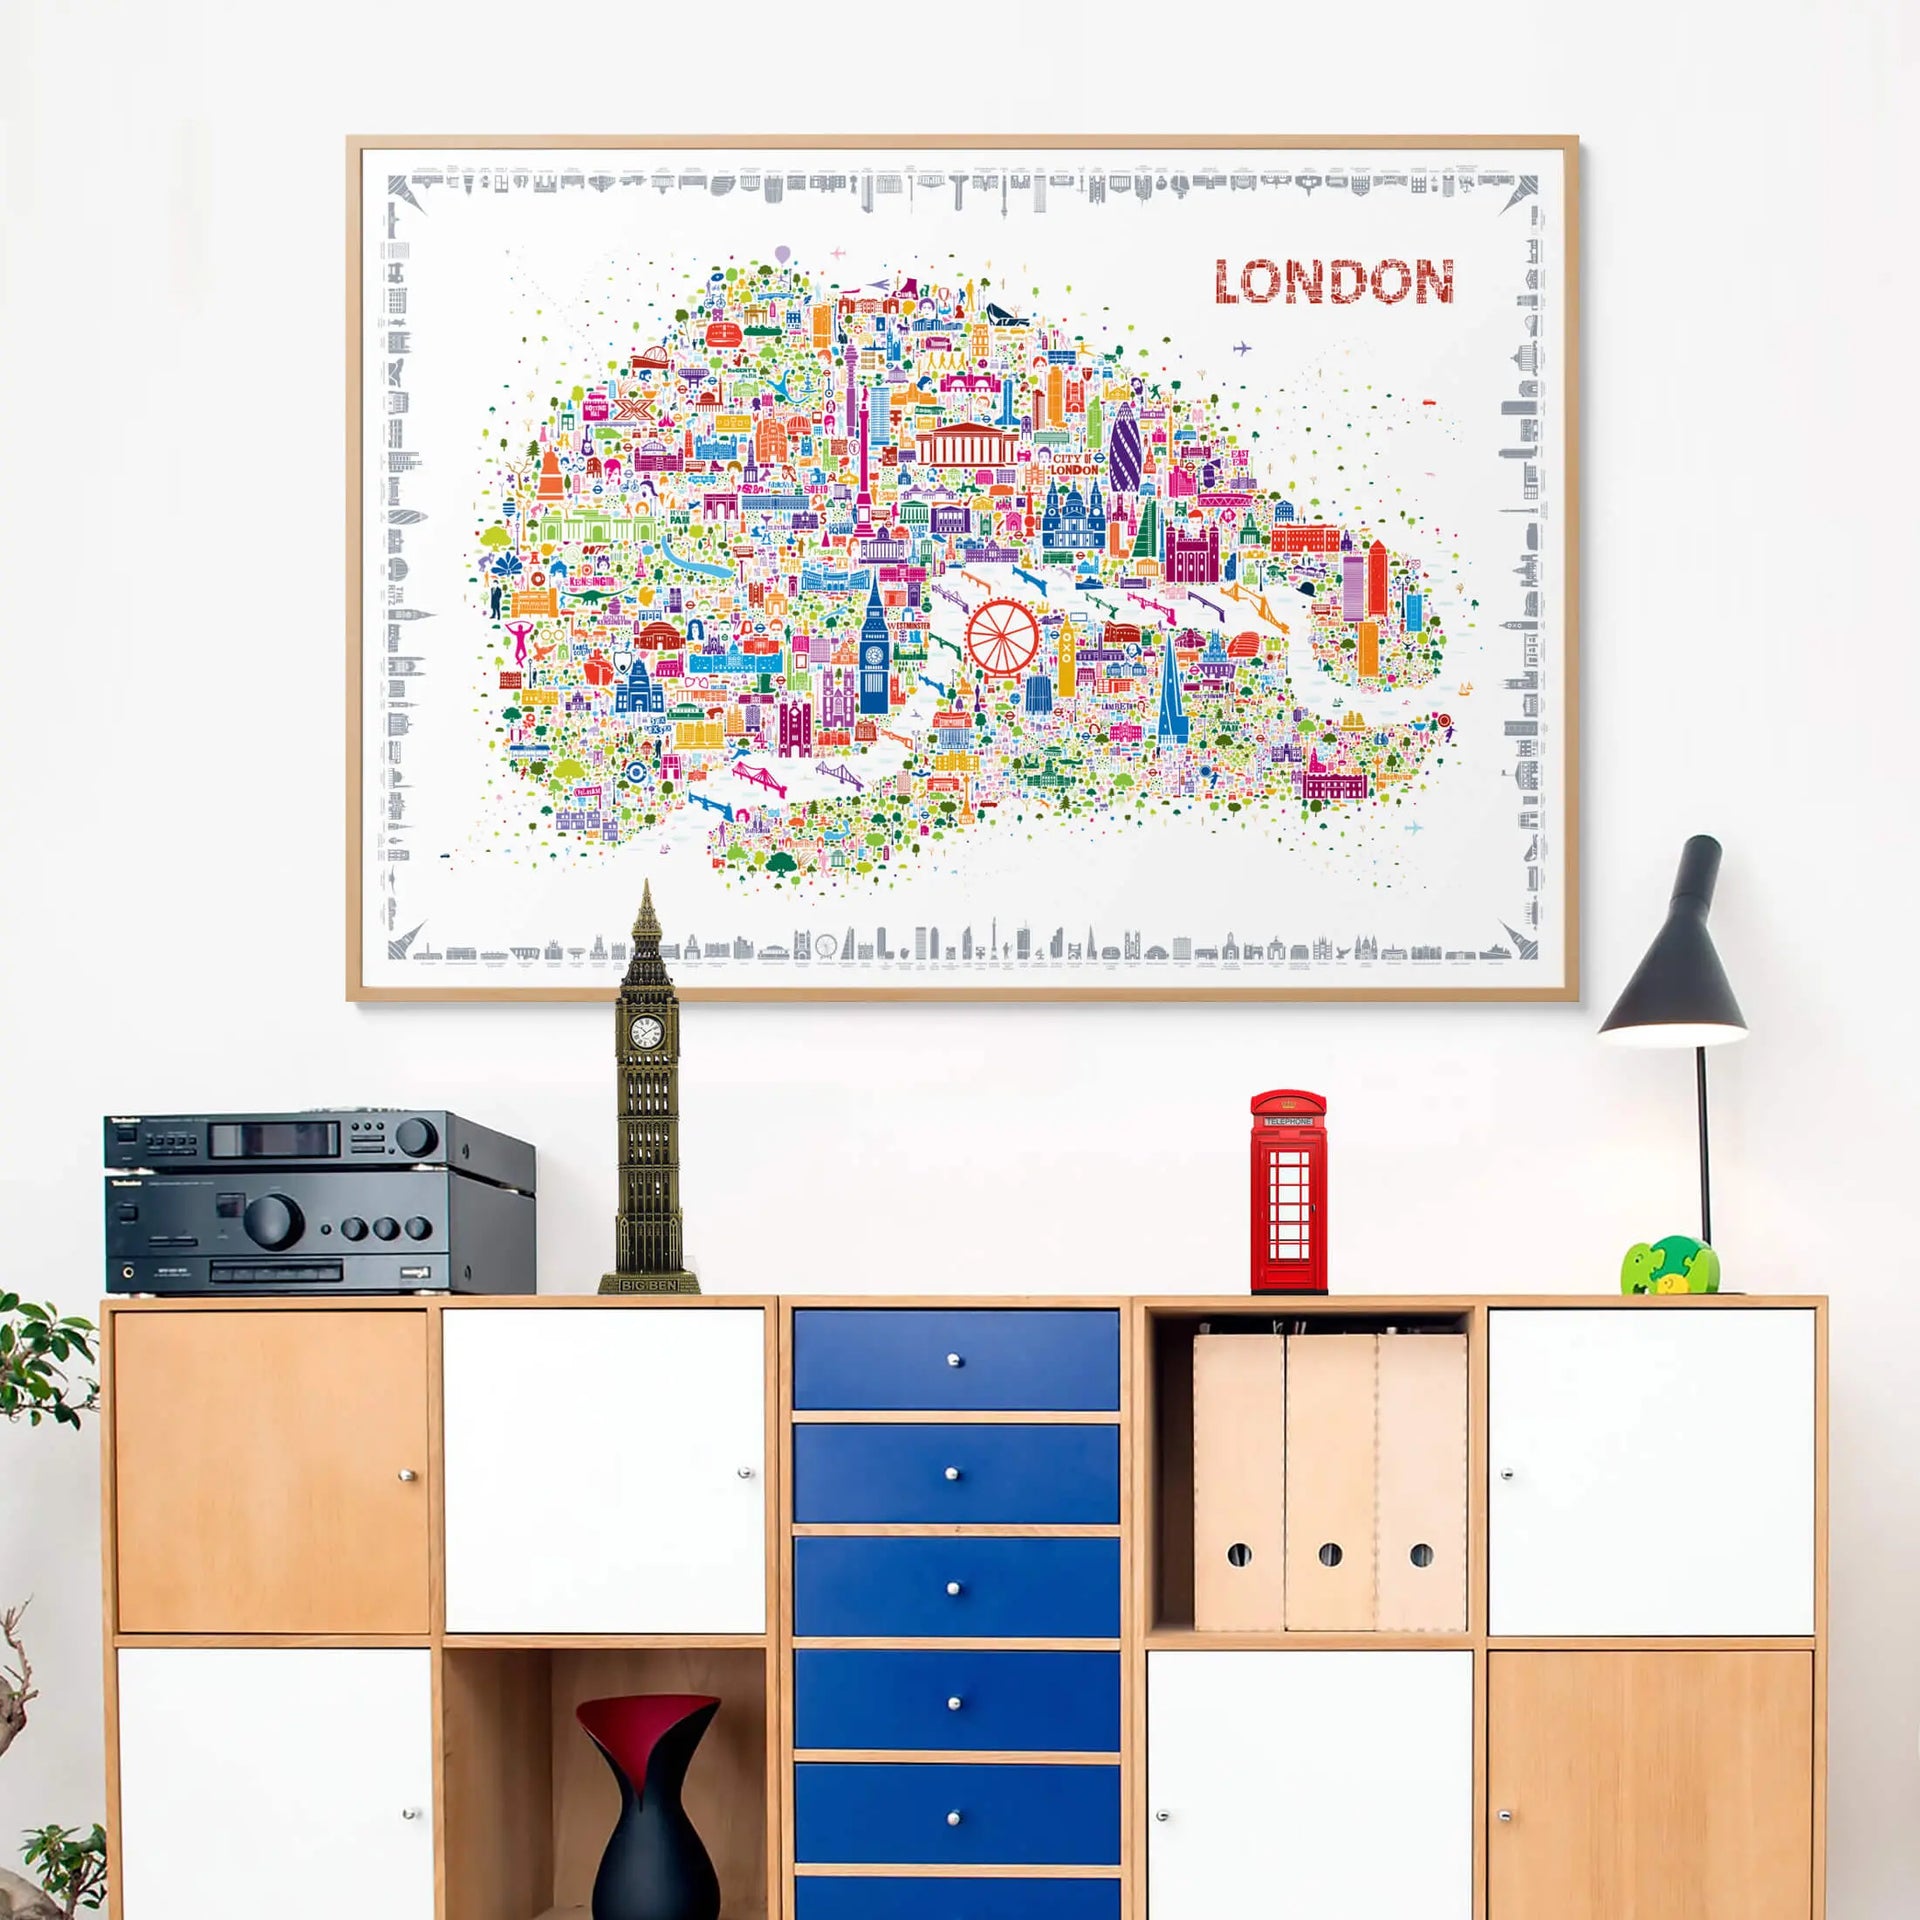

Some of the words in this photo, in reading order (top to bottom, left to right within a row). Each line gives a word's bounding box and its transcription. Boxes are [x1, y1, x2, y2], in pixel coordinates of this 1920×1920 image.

[1215, 258, 1454, 306] LONDON
[1053, 454, 1082, 464] CITY
[1231, 450, 1249, 458] EAST
[1051, 465, 1099, 475] LONDON
[887, 622, 931, 630] WESTMINSTER
[1061, 632, 1072, 664] OXO
[1266, 1117, 1312, 1125] TELEPHONE
[622, 1281, 645, 1291] BIG
[649, 1281, 677, 1291] BEN
